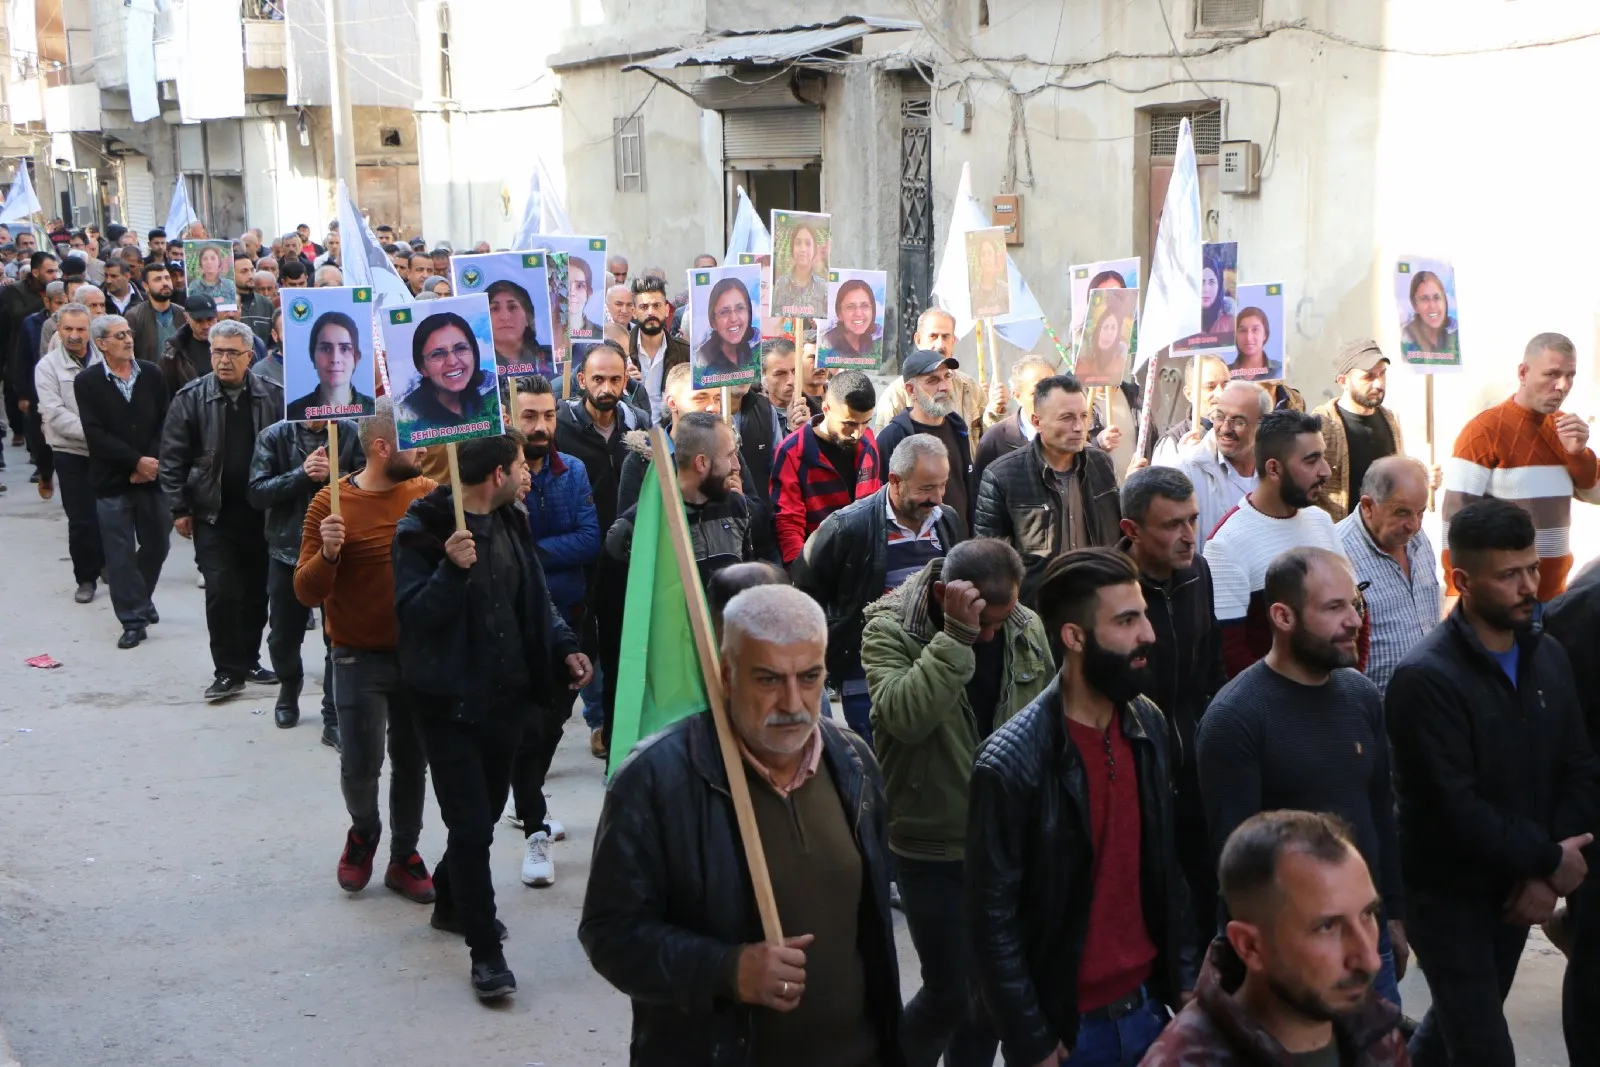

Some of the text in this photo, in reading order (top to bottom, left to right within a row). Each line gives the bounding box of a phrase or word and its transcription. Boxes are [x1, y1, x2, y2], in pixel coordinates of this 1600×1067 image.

[507, 363, 534, 374] SARA
[440, 426, 457, 436] ROJ
[459, 421, 490, 434] XABOR
